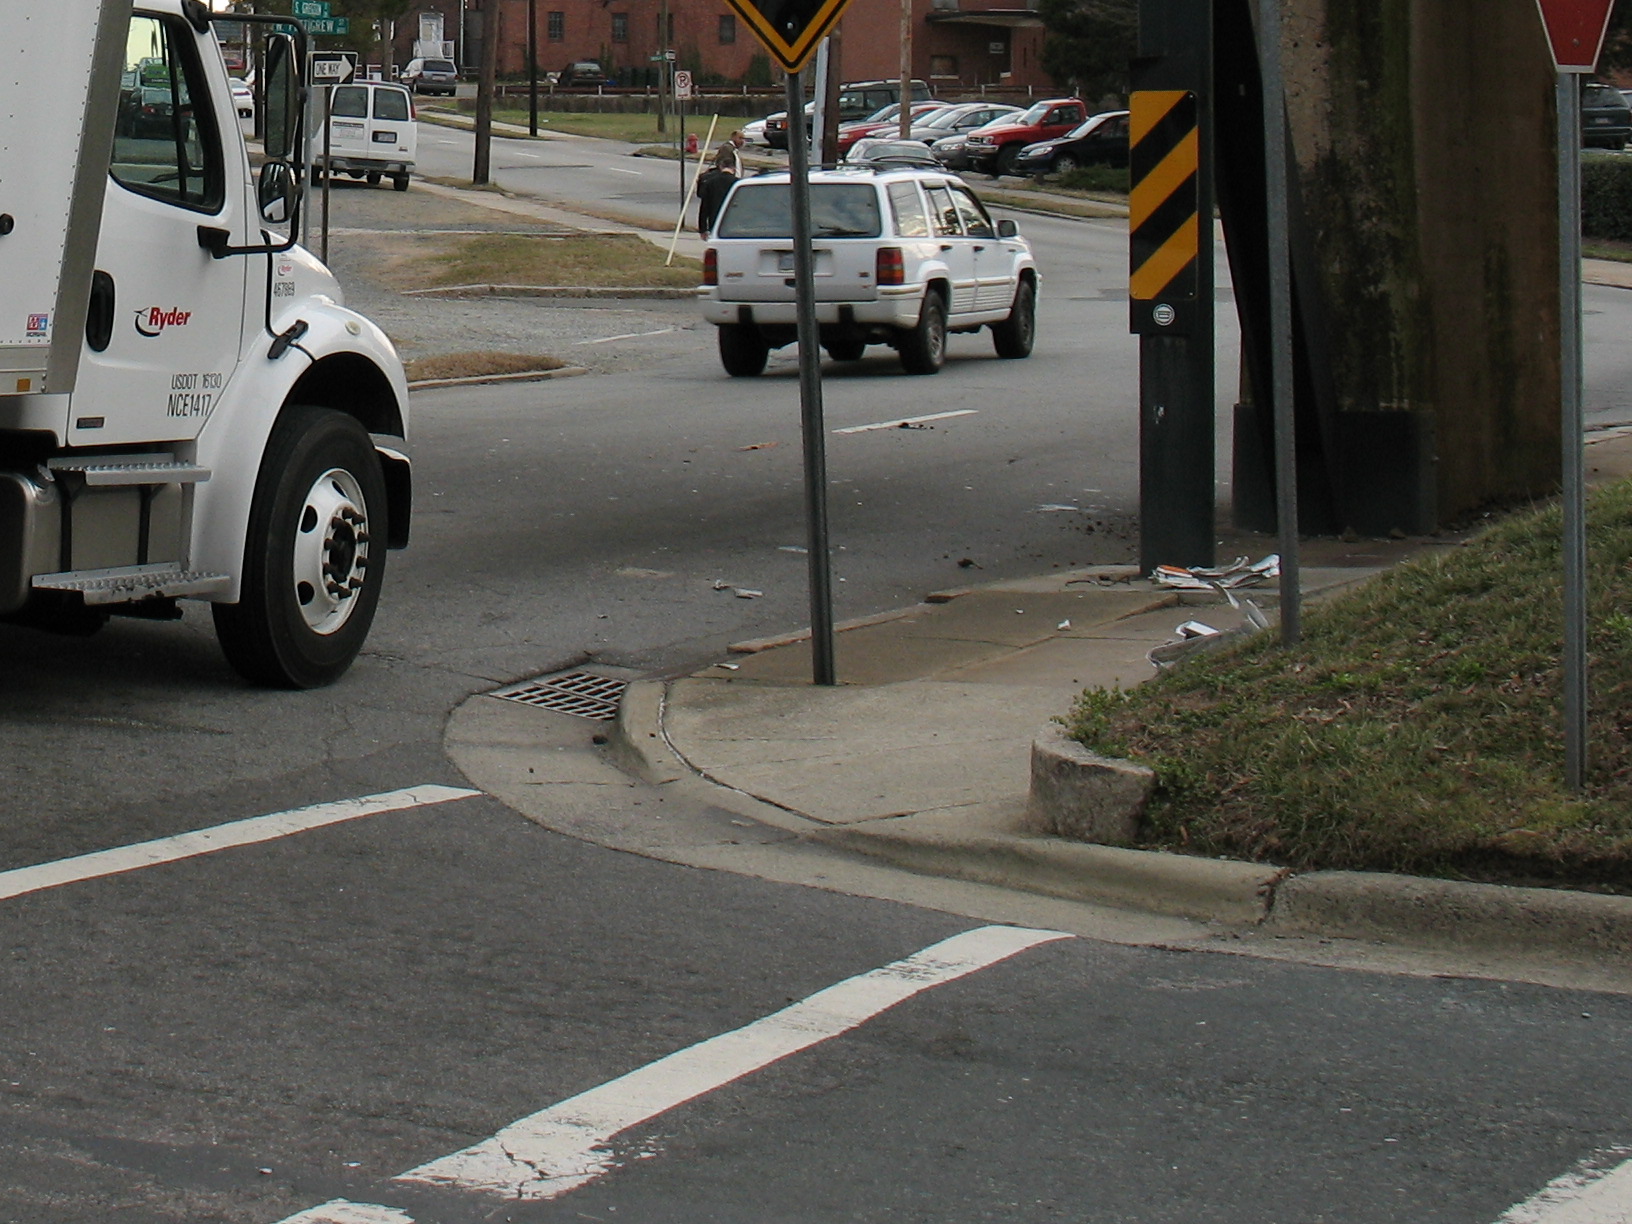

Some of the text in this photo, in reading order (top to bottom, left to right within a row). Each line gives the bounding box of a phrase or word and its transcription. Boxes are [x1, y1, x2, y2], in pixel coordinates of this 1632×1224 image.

[149, 307, 191, 330] Ryder
[171, 373, 198, 390] USDOT
[167, 393, 212, 417] NCE1417
